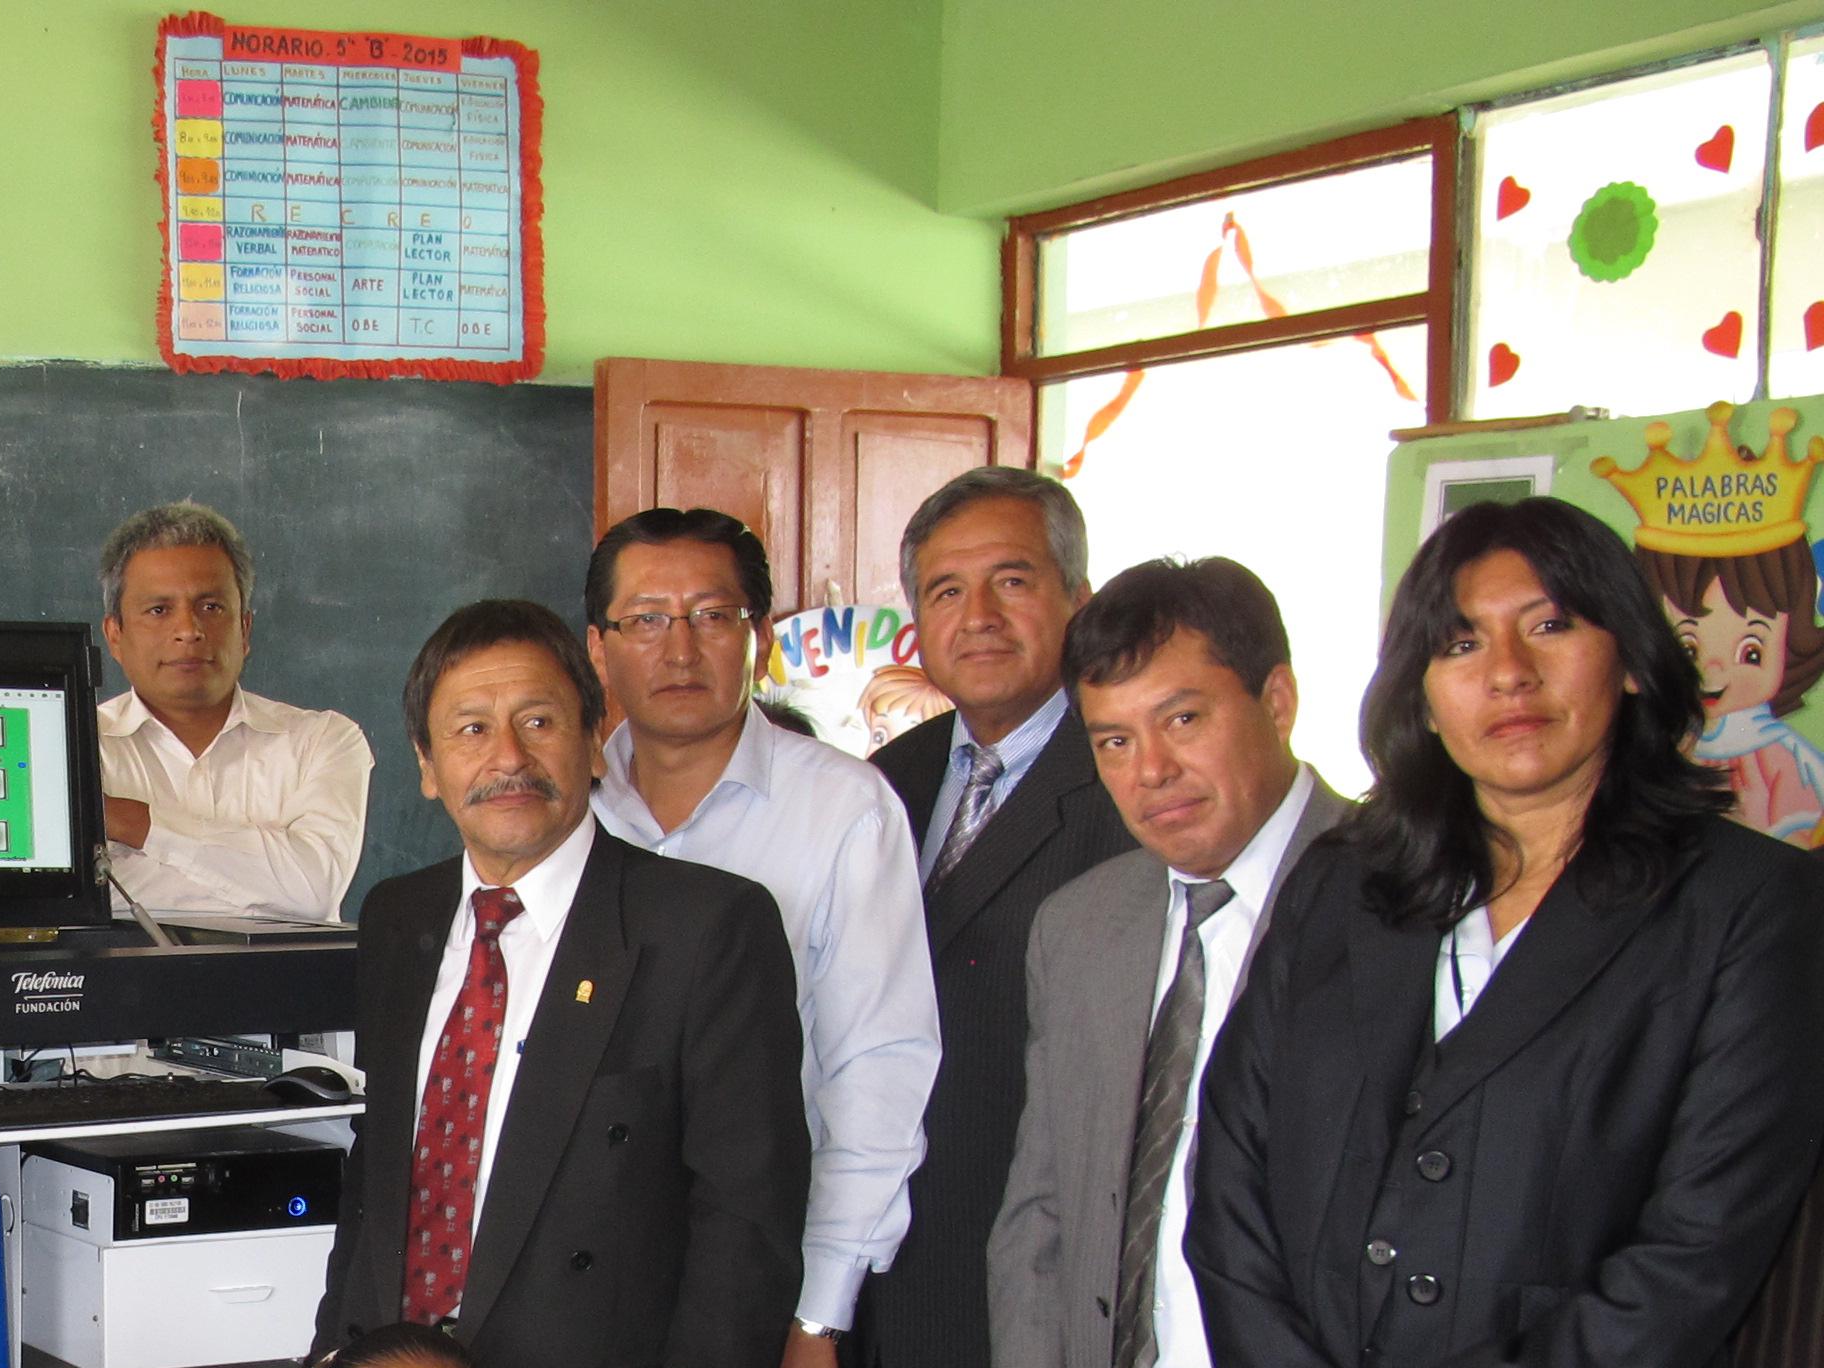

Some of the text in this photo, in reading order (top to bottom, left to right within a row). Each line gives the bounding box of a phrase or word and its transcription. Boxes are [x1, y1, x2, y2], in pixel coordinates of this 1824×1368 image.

[231, 32, 324, 58] HORARIO
[402, 42, 448, 65] 2015
[412, 233, 442, 245] PLAN
[236, 241, 277, 255] VERBAL
[404, 249, 451, 262] LECTOR
[290, 269, 337, 282] PERSONAL
[412, 272, 443, 286] PLAN
[351, 279, 384, 291] ARTE
[295, 287, 331, 297] SOCIAL
[403, 288, 453, 302] LECTOR
[291, 307, 337, 319] PERSONAL
[297, 323, 333, 333] SOCIAL
[1656, 473, 1778, 499] PALABRAS
[1667, 501, 1764, 525] MAGICAS
[15, 999, 80, 1014] FUNDACIÓN
